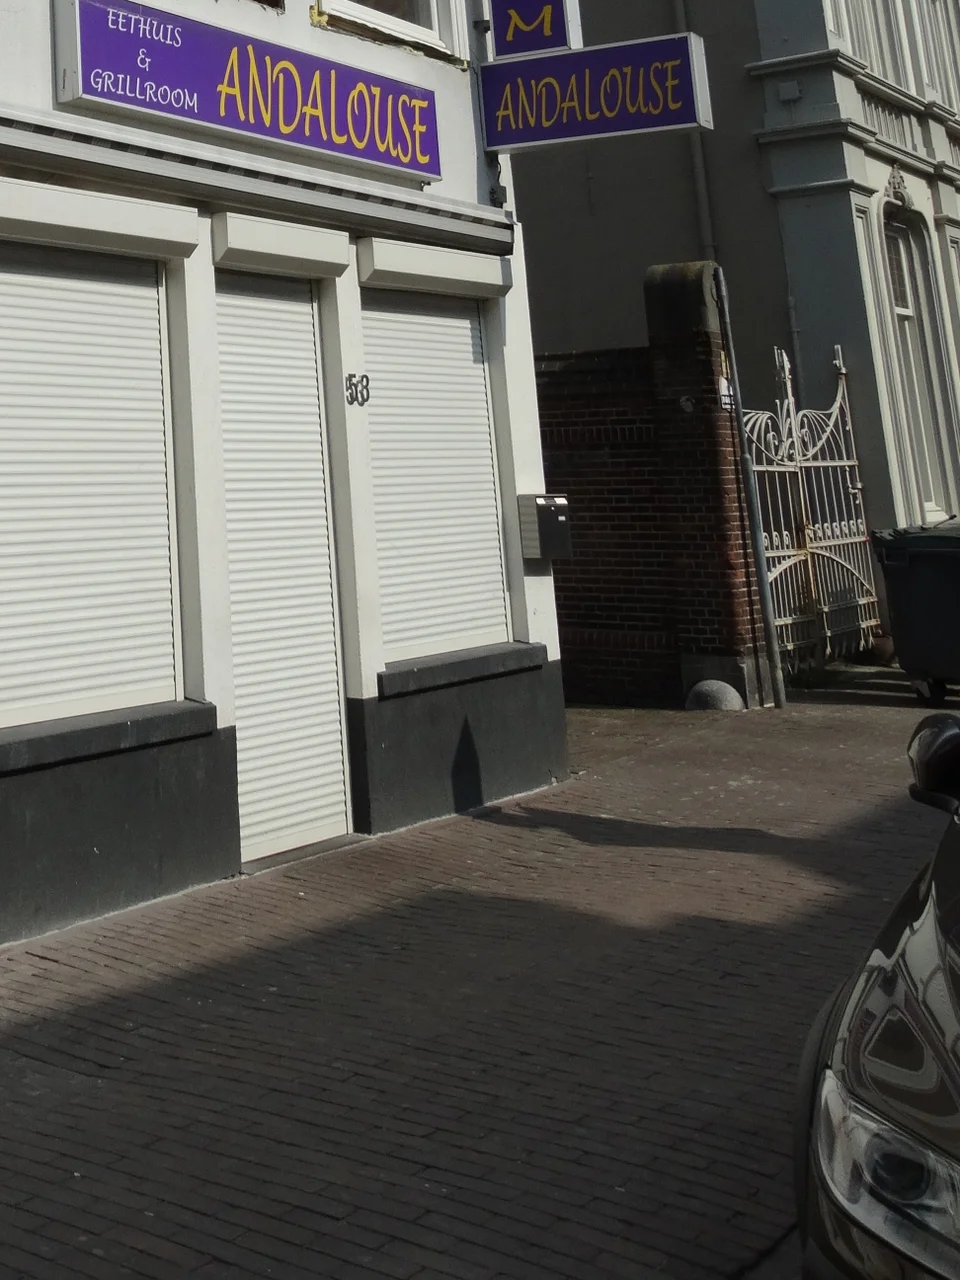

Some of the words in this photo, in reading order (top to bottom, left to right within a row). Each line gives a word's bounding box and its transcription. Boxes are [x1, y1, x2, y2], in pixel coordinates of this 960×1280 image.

[107, 8, 182, 48] EETHUIS
[137, 49, 151, 71] &
[90, 69, 199, 113] GRILLROOM
[217, 44, 430, 164] ANDALOUSE
[496, 59, 683, 132] ANDALOUSE
[345, 373, 370, 407] 58
